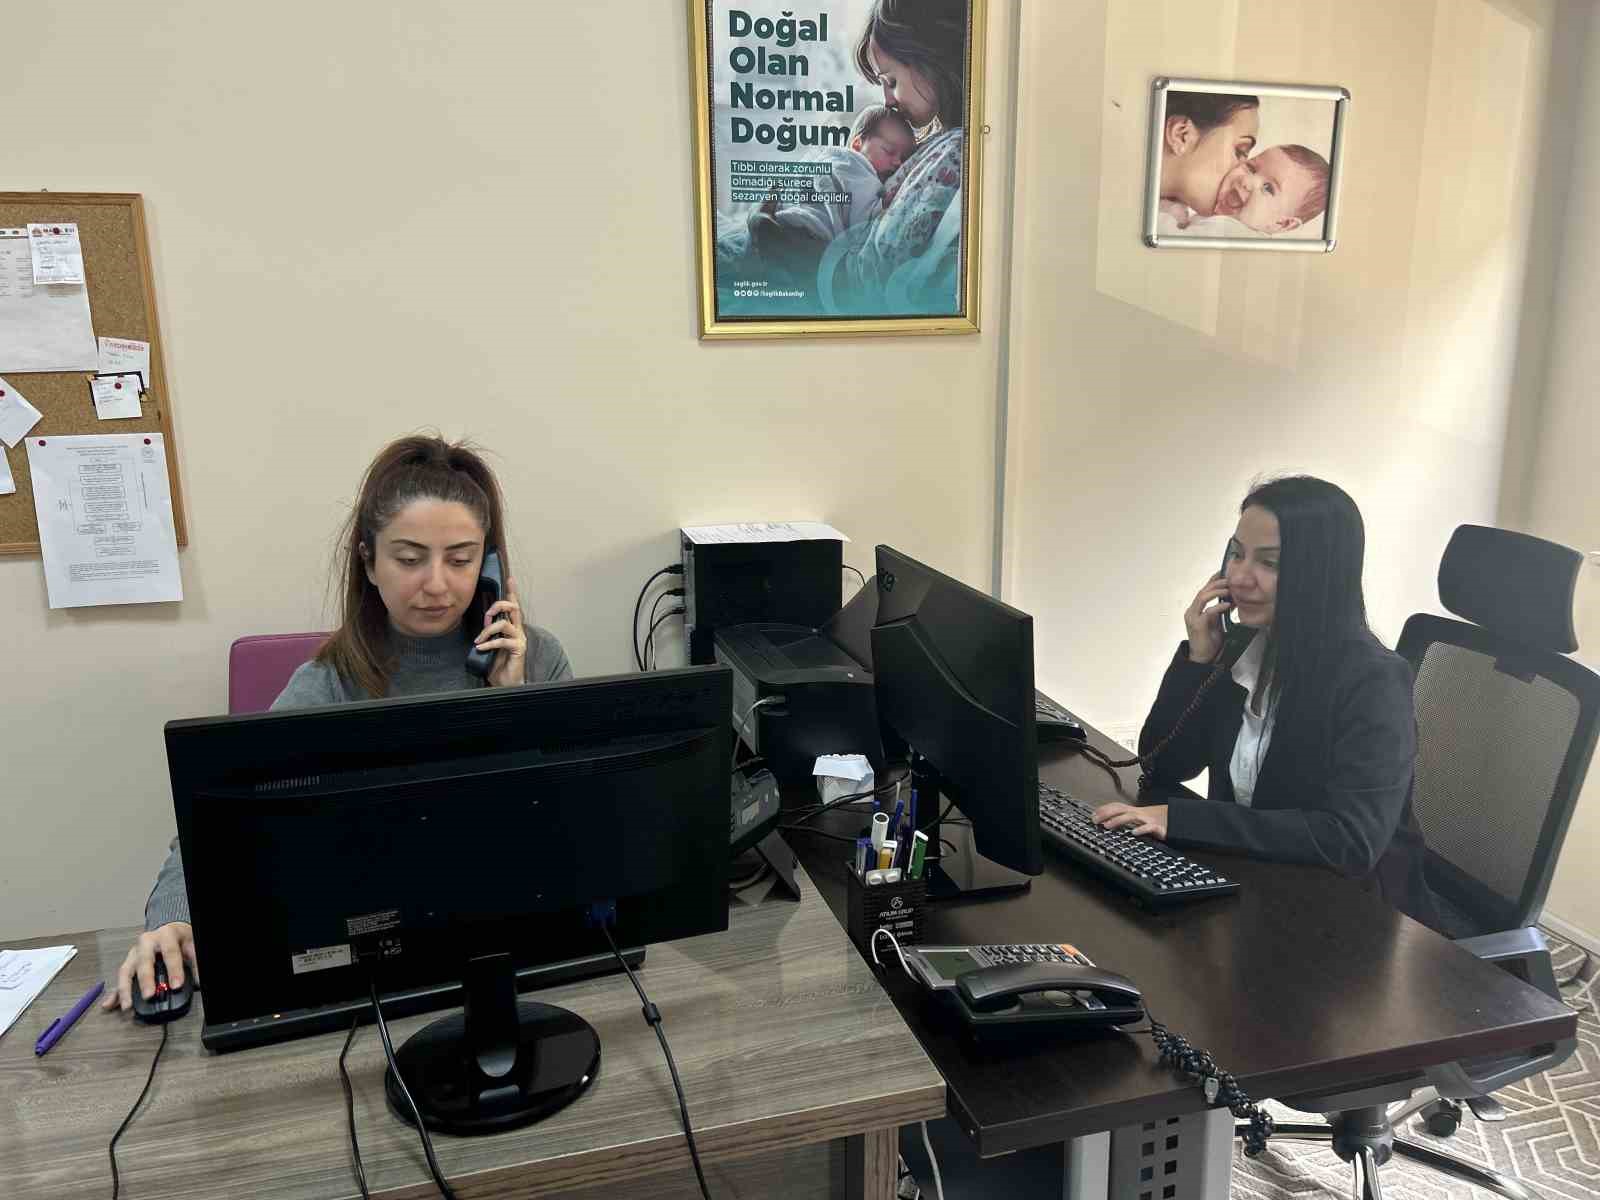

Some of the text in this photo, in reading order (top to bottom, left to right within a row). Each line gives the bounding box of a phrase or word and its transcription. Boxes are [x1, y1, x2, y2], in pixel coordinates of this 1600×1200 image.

[729, 10, 828, 47] Doğal
[729, 46, 809, 76] Olan
[730, 81, 854, 112] Normal
[731, 117, 851, 152] Doğum
[732, 177, 812, 188] olmadığı sürece
[759, 163, 790, 173] olarak
[792, 164, 831, 174] zorunlu
[732, 191, 851, 203] sezaryen doğal değildir.
